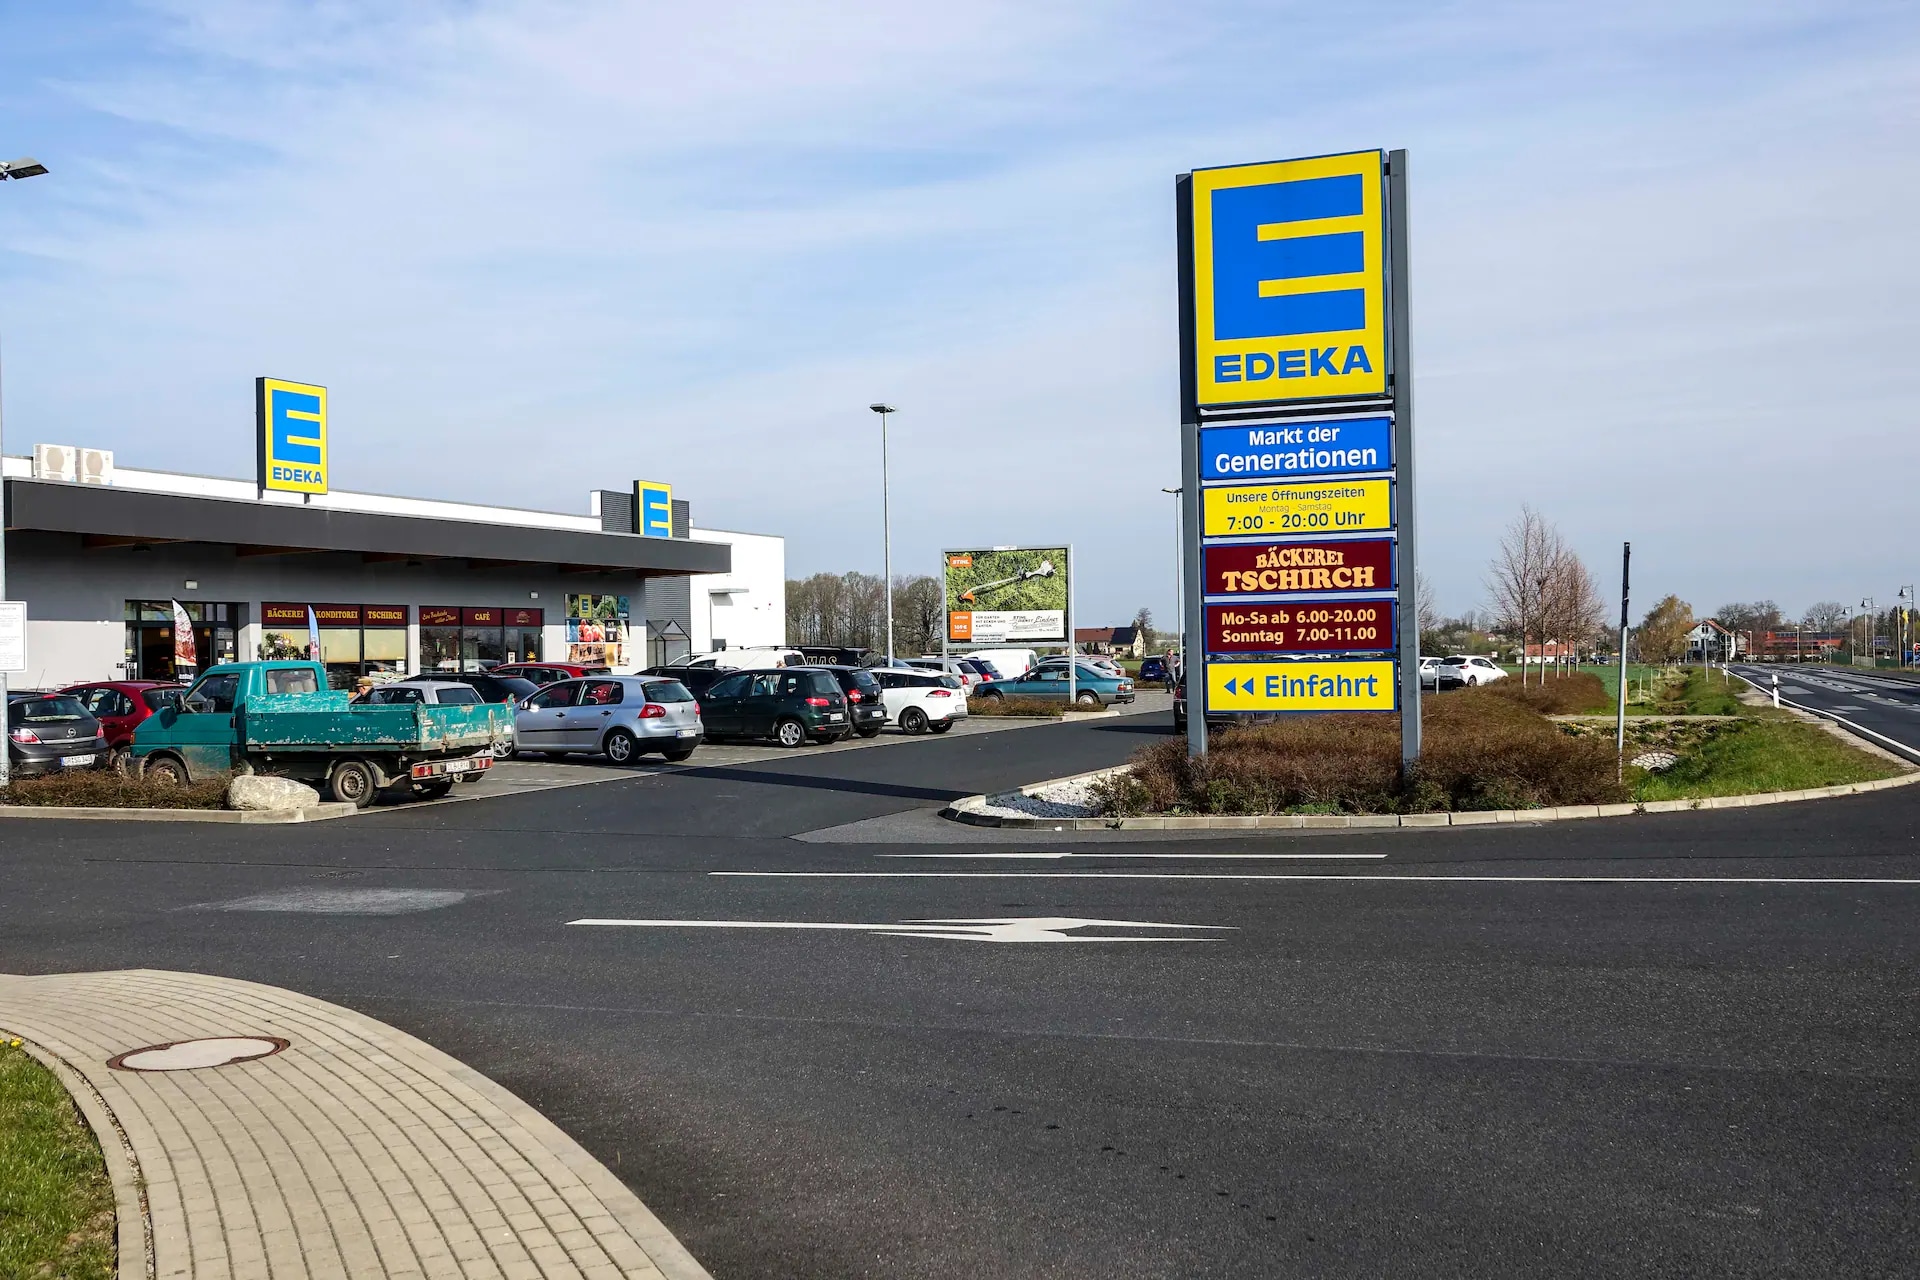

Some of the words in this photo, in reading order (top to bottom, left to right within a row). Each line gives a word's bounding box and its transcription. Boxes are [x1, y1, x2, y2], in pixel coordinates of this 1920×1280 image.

[1211, 173, 1366, 341] E
[1214, 345, 1373, 383] EDEKA
[271, 388, 321, 465] E
[1249, 428, 1303, 446] Markt
[1308, 426, 1340, 442] der
[1215, 447, 1377, 473] Generationen
[272, 466, 323, 485] EDEKA
[1226, 492, 1267, 503] Unsere
[1271, 487, 1365, 501] Öffnungszeiten
[643, 488, 669, 538] E
[1259, 504, 1289, 513] Montag
[1297, 502, 1332, 512] Samstag
[1227, 515, 1263, 530] 7:00
[1281, 513, 1329, 528] 20:00
[1335, 511, 1366, 526] Uhr
[1256, 546, 1344, 568] BÄCKEREI
[1221, 566, 1375, 591] TSCHIRCH
[266, 607, 304, 618] BÄCKEREI
[315, 610, 358, 619] KONDITOREI
[367, 610, 403, 620] TSCHIRCH
[474, 611, 491, 621] CAFÉ
[1221, 611, 1268, 626] Mo-Sa
[1271, 610, 1290, 624] ab
[1296, 609, 1377, 623] 6.00-20.00
[1222, 630, 1284, 644] Sonntag
[1296, 627, 1377, 641] 7.00-11.00
[1266, 673, 1378, 698] Einfahrt
